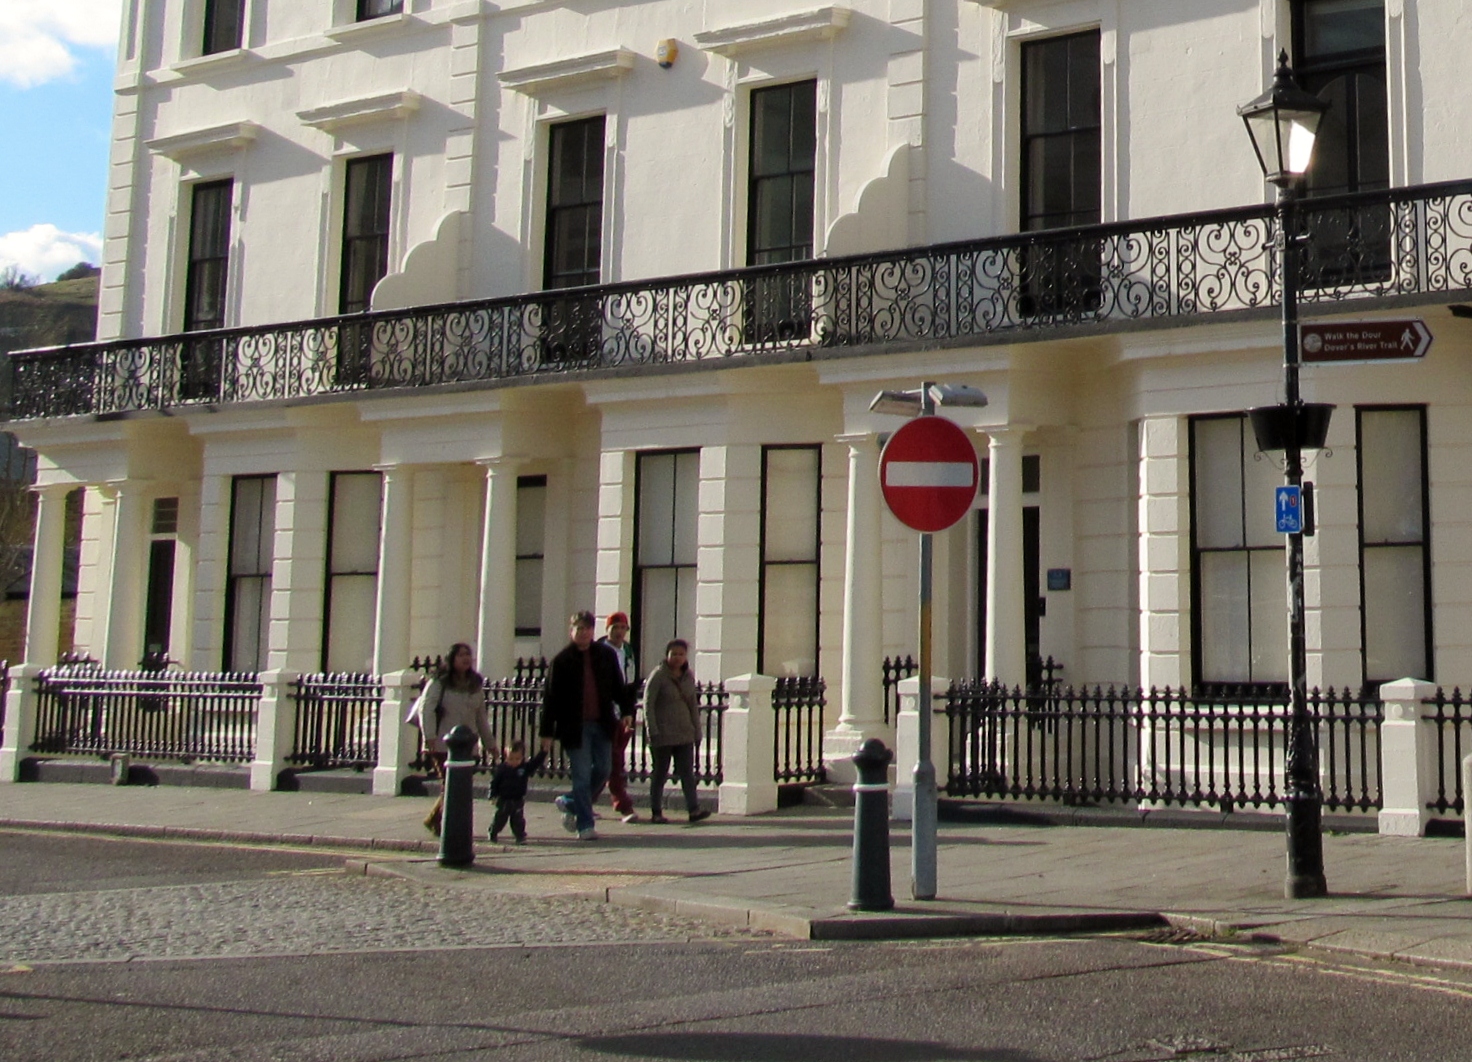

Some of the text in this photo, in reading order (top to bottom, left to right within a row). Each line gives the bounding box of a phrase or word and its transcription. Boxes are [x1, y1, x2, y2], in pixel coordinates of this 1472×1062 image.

[1324, 331, 1381, 340] Walk the Dour
[1324, 341, 1398, 351] Dover's River Trail
